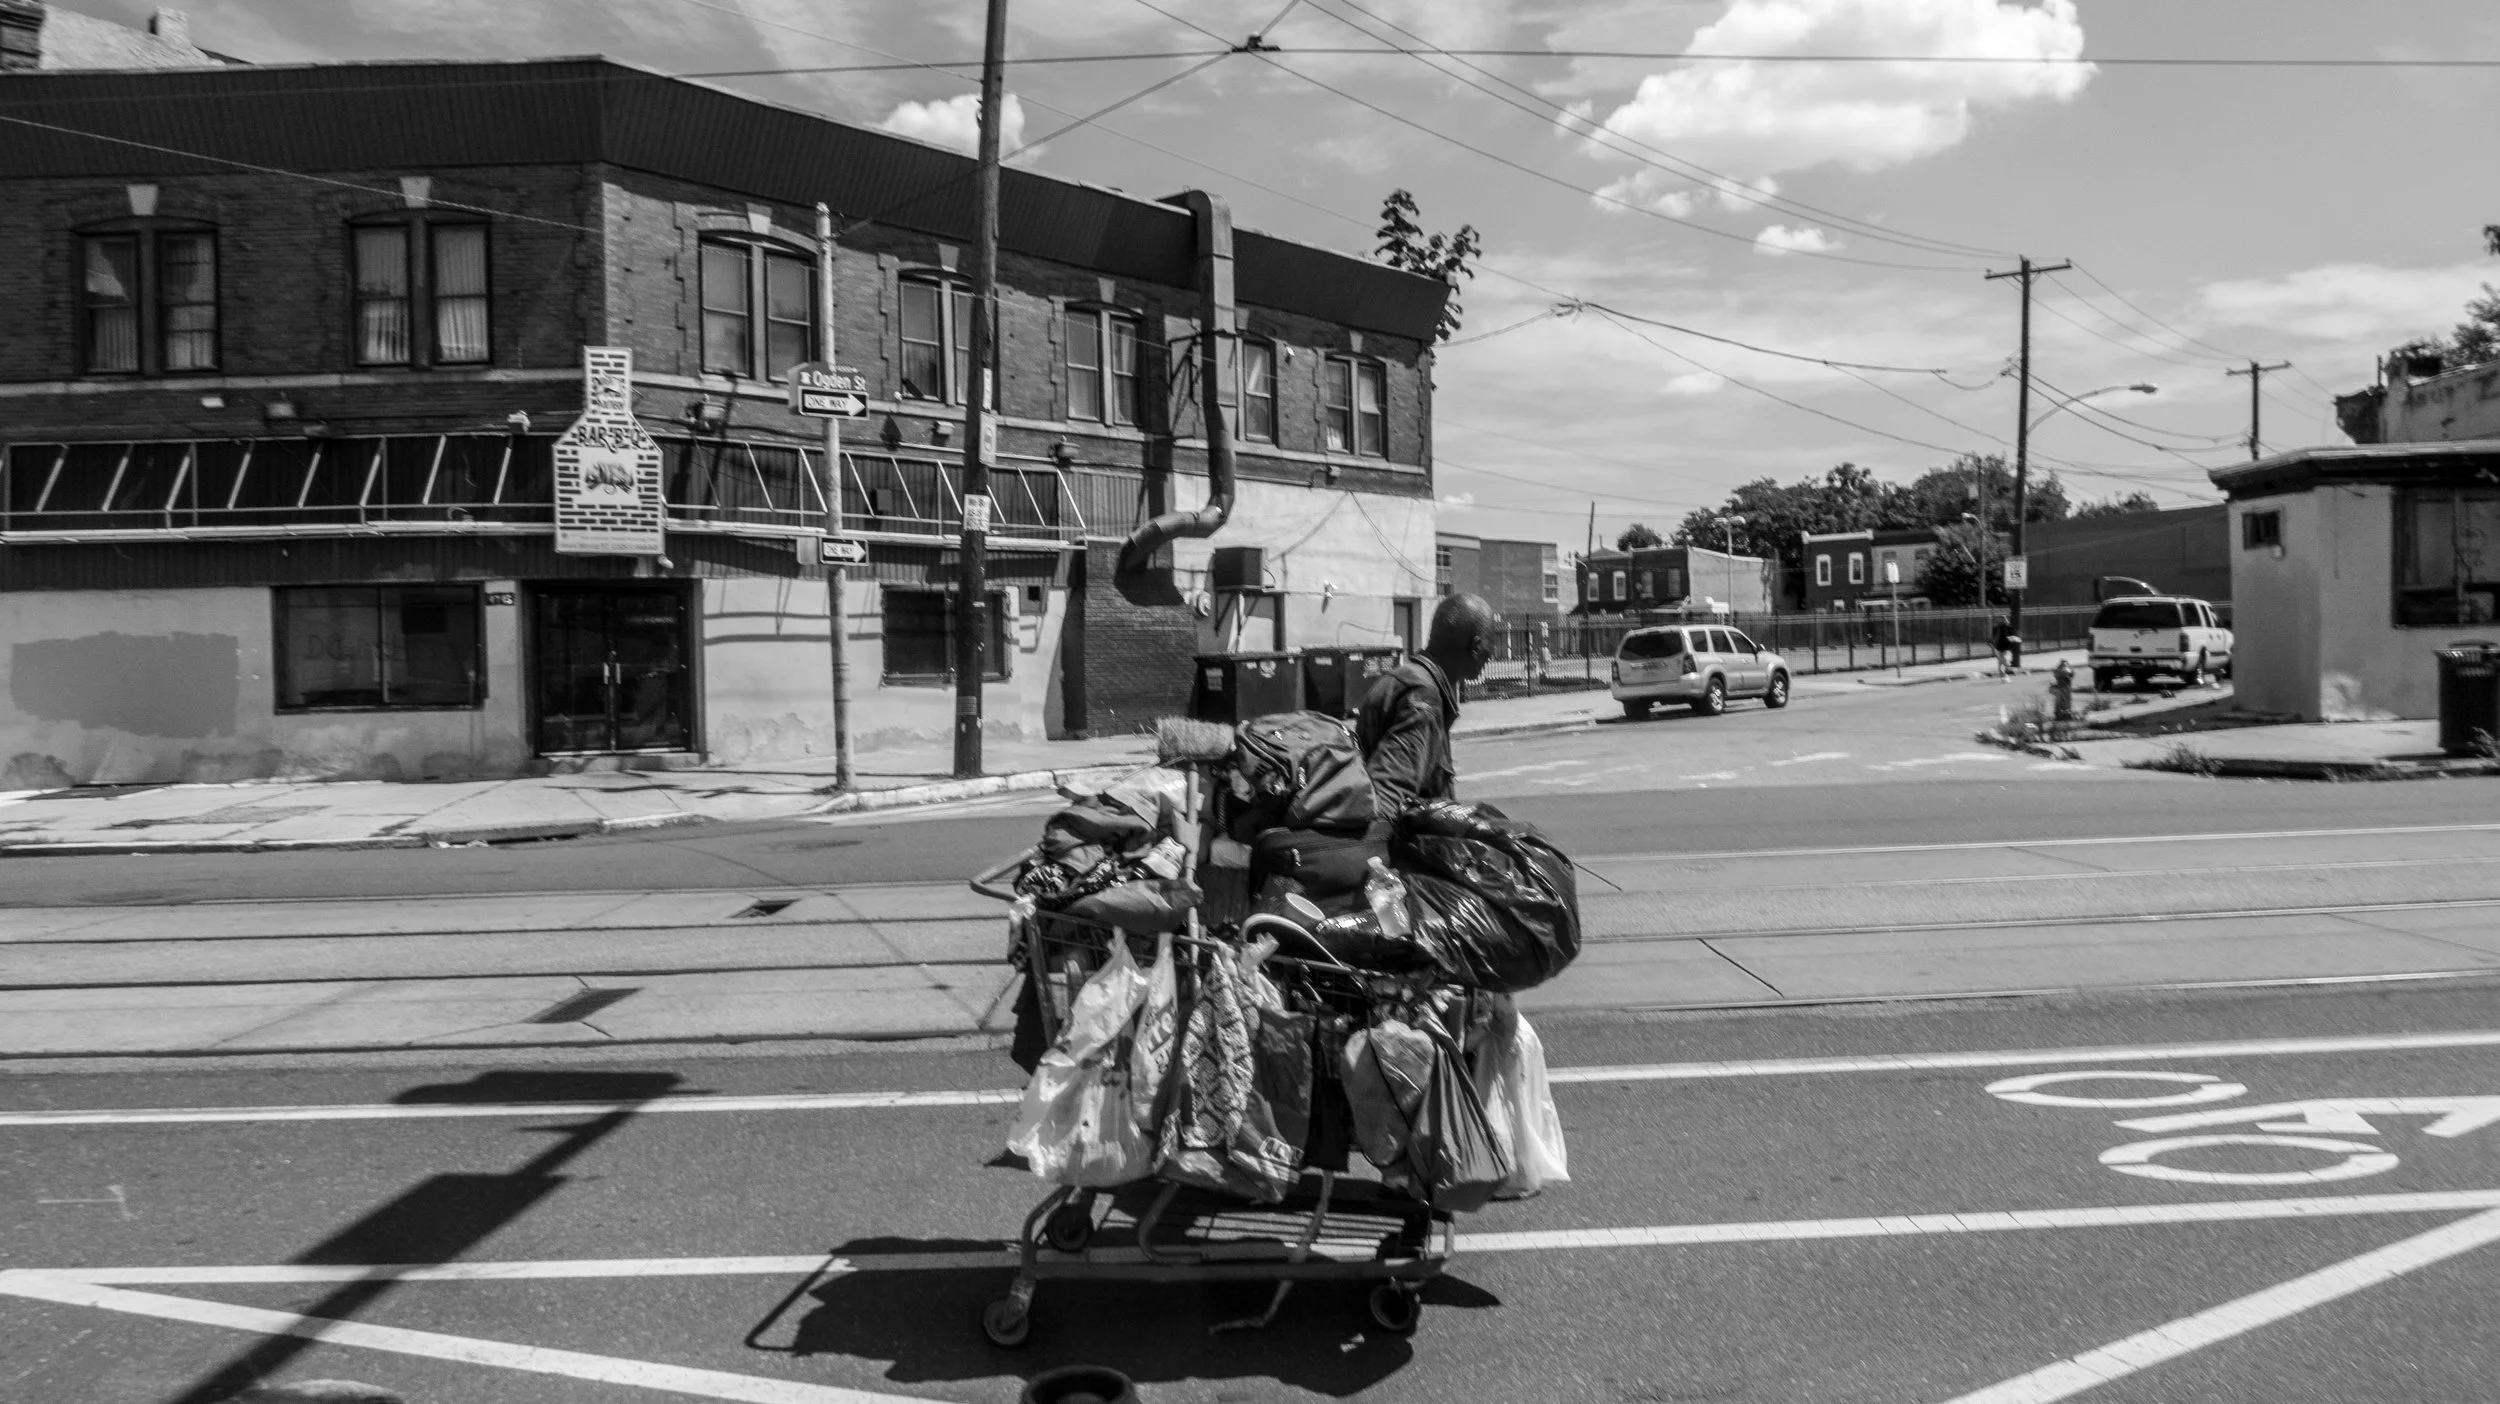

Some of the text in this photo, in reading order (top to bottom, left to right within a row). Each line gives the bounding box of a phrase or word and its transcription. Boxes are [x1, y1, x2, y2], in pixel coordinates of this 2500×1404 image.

[813, 370, 852, 390] Ogden
[853, 375, 867, 391] St
[807, 395, 847, 409] ONE WAY
[825, 543, 839, 555] ONE
